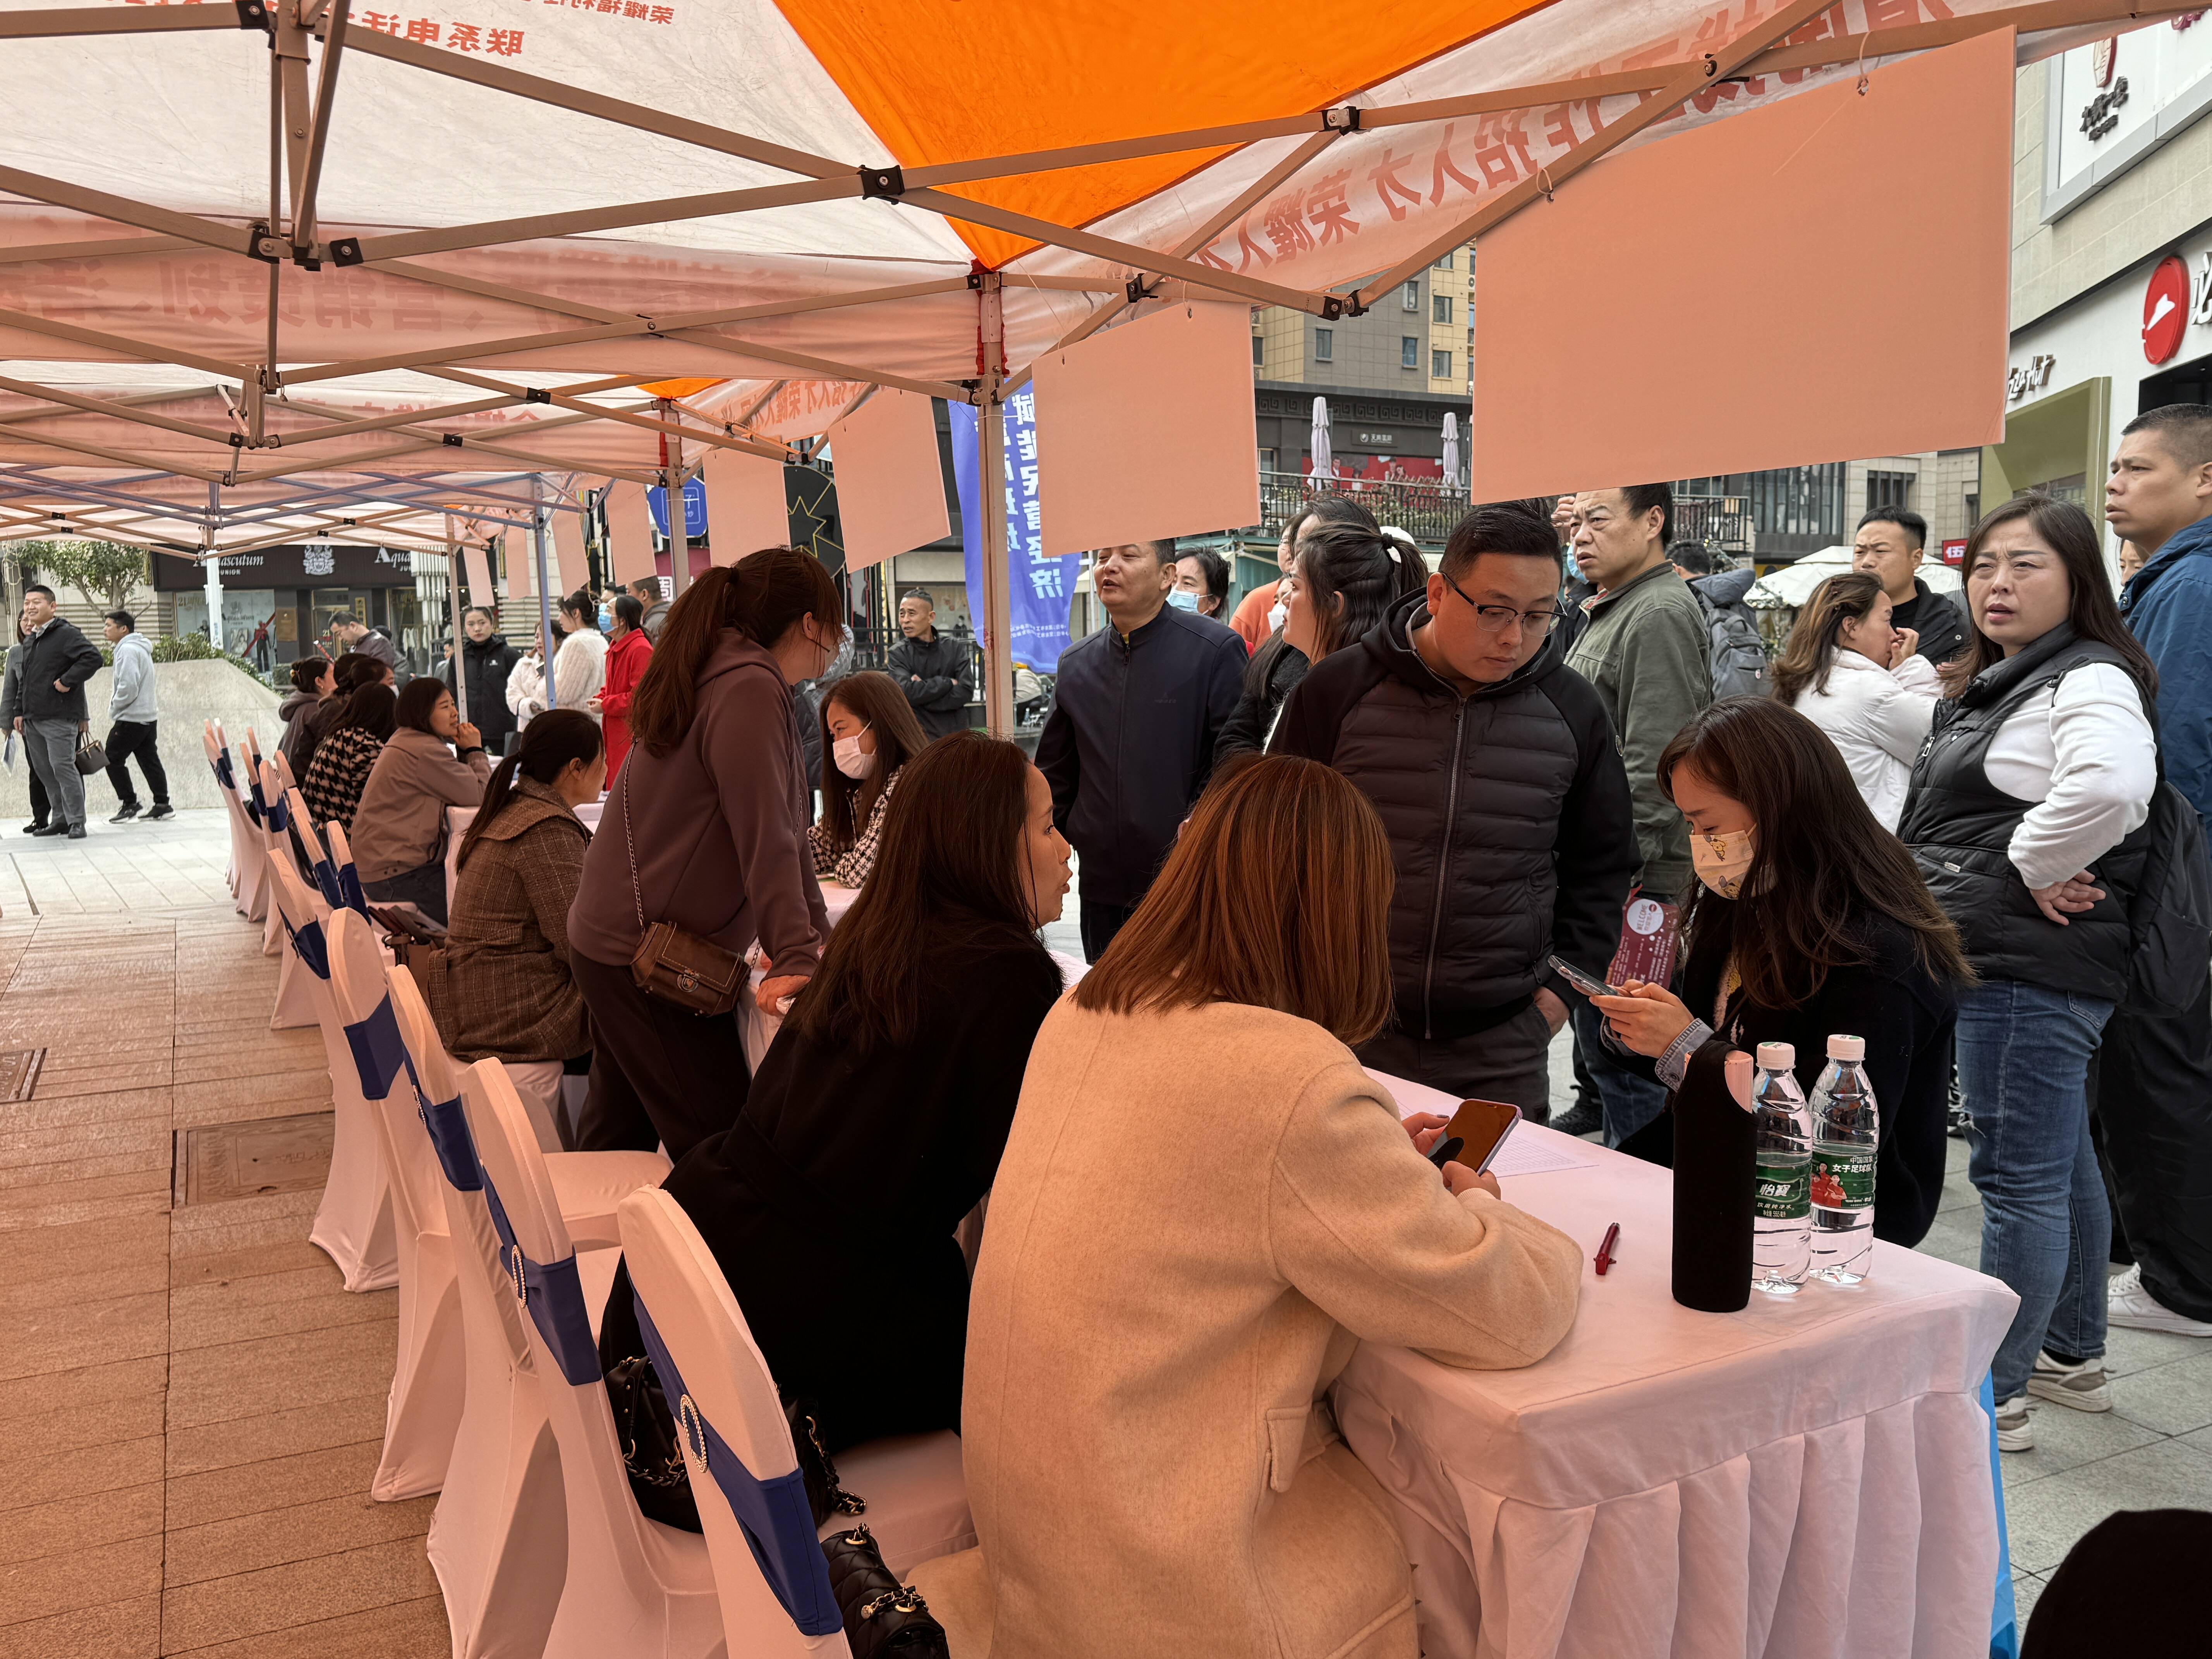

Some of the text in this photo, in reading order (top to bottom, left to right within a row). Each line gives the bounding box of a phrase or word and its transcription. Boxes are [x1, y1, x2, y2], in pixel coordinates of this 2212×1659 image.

[193, 555, 263, 567] ascutum
[1637, 903, 1648, 931] WELCOME
[1850, 1156, 1873, 1164] 中国国家
[1832, 1164, 1872, 1173] 女子足球队
